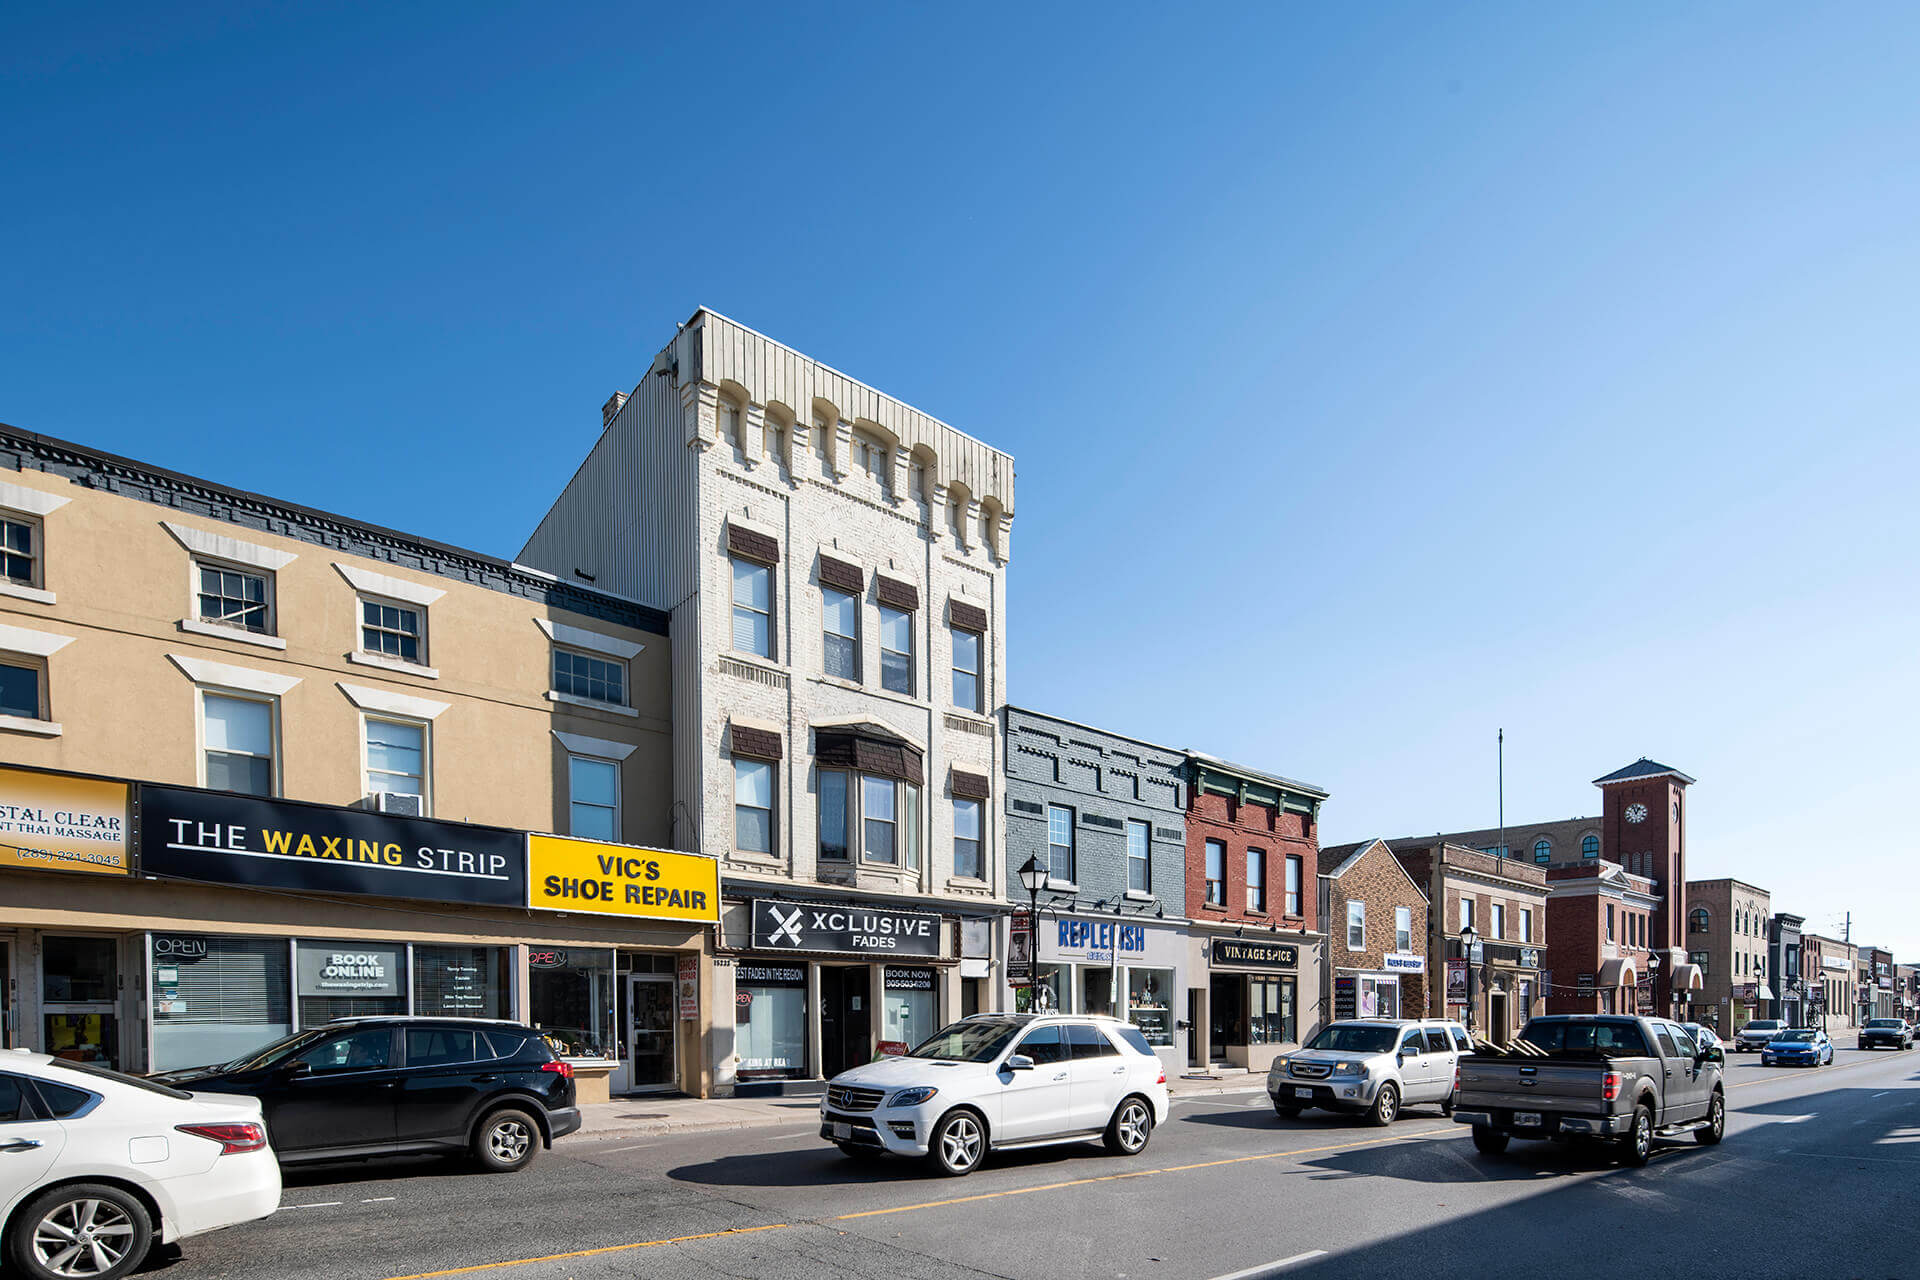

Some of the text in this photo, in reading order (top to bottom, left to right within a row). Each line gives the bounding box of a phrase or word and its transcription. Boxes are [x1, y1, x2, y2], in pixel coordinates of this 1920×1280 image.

[54, 811, 120, 831] CLEAR
[16, 822, 51, 835] THAI
[54, 827, 121, 842] MASSAGE
[168, 818, 506, 875] THE WAXING STRIP
[57, 850, 120, 866] 221-3045
[597, 854, 661, 881] VIC'S
[544, 875, 707, 911] SHOE REPAIR
[811, 911, 932, 937] XCLUSIVE
[155, 938, 206, 954] OPEN
[852, 935, 896, 948] FADES
[331, 953, 379, 966] BOOK
[528, 951, 567, 964] OPEN
[1224, 945, 1292, 962] VINTAGE SPICE
[325, 965, 385, 977] ONLINE
[736, 966, 748, 979] EST
[748, 967, 766, 980] FADES
[772, 967, 783, 980] THE
[885, 969, 932, 979] BOOK NOW
[736, 992, 751, 1003] PEN
